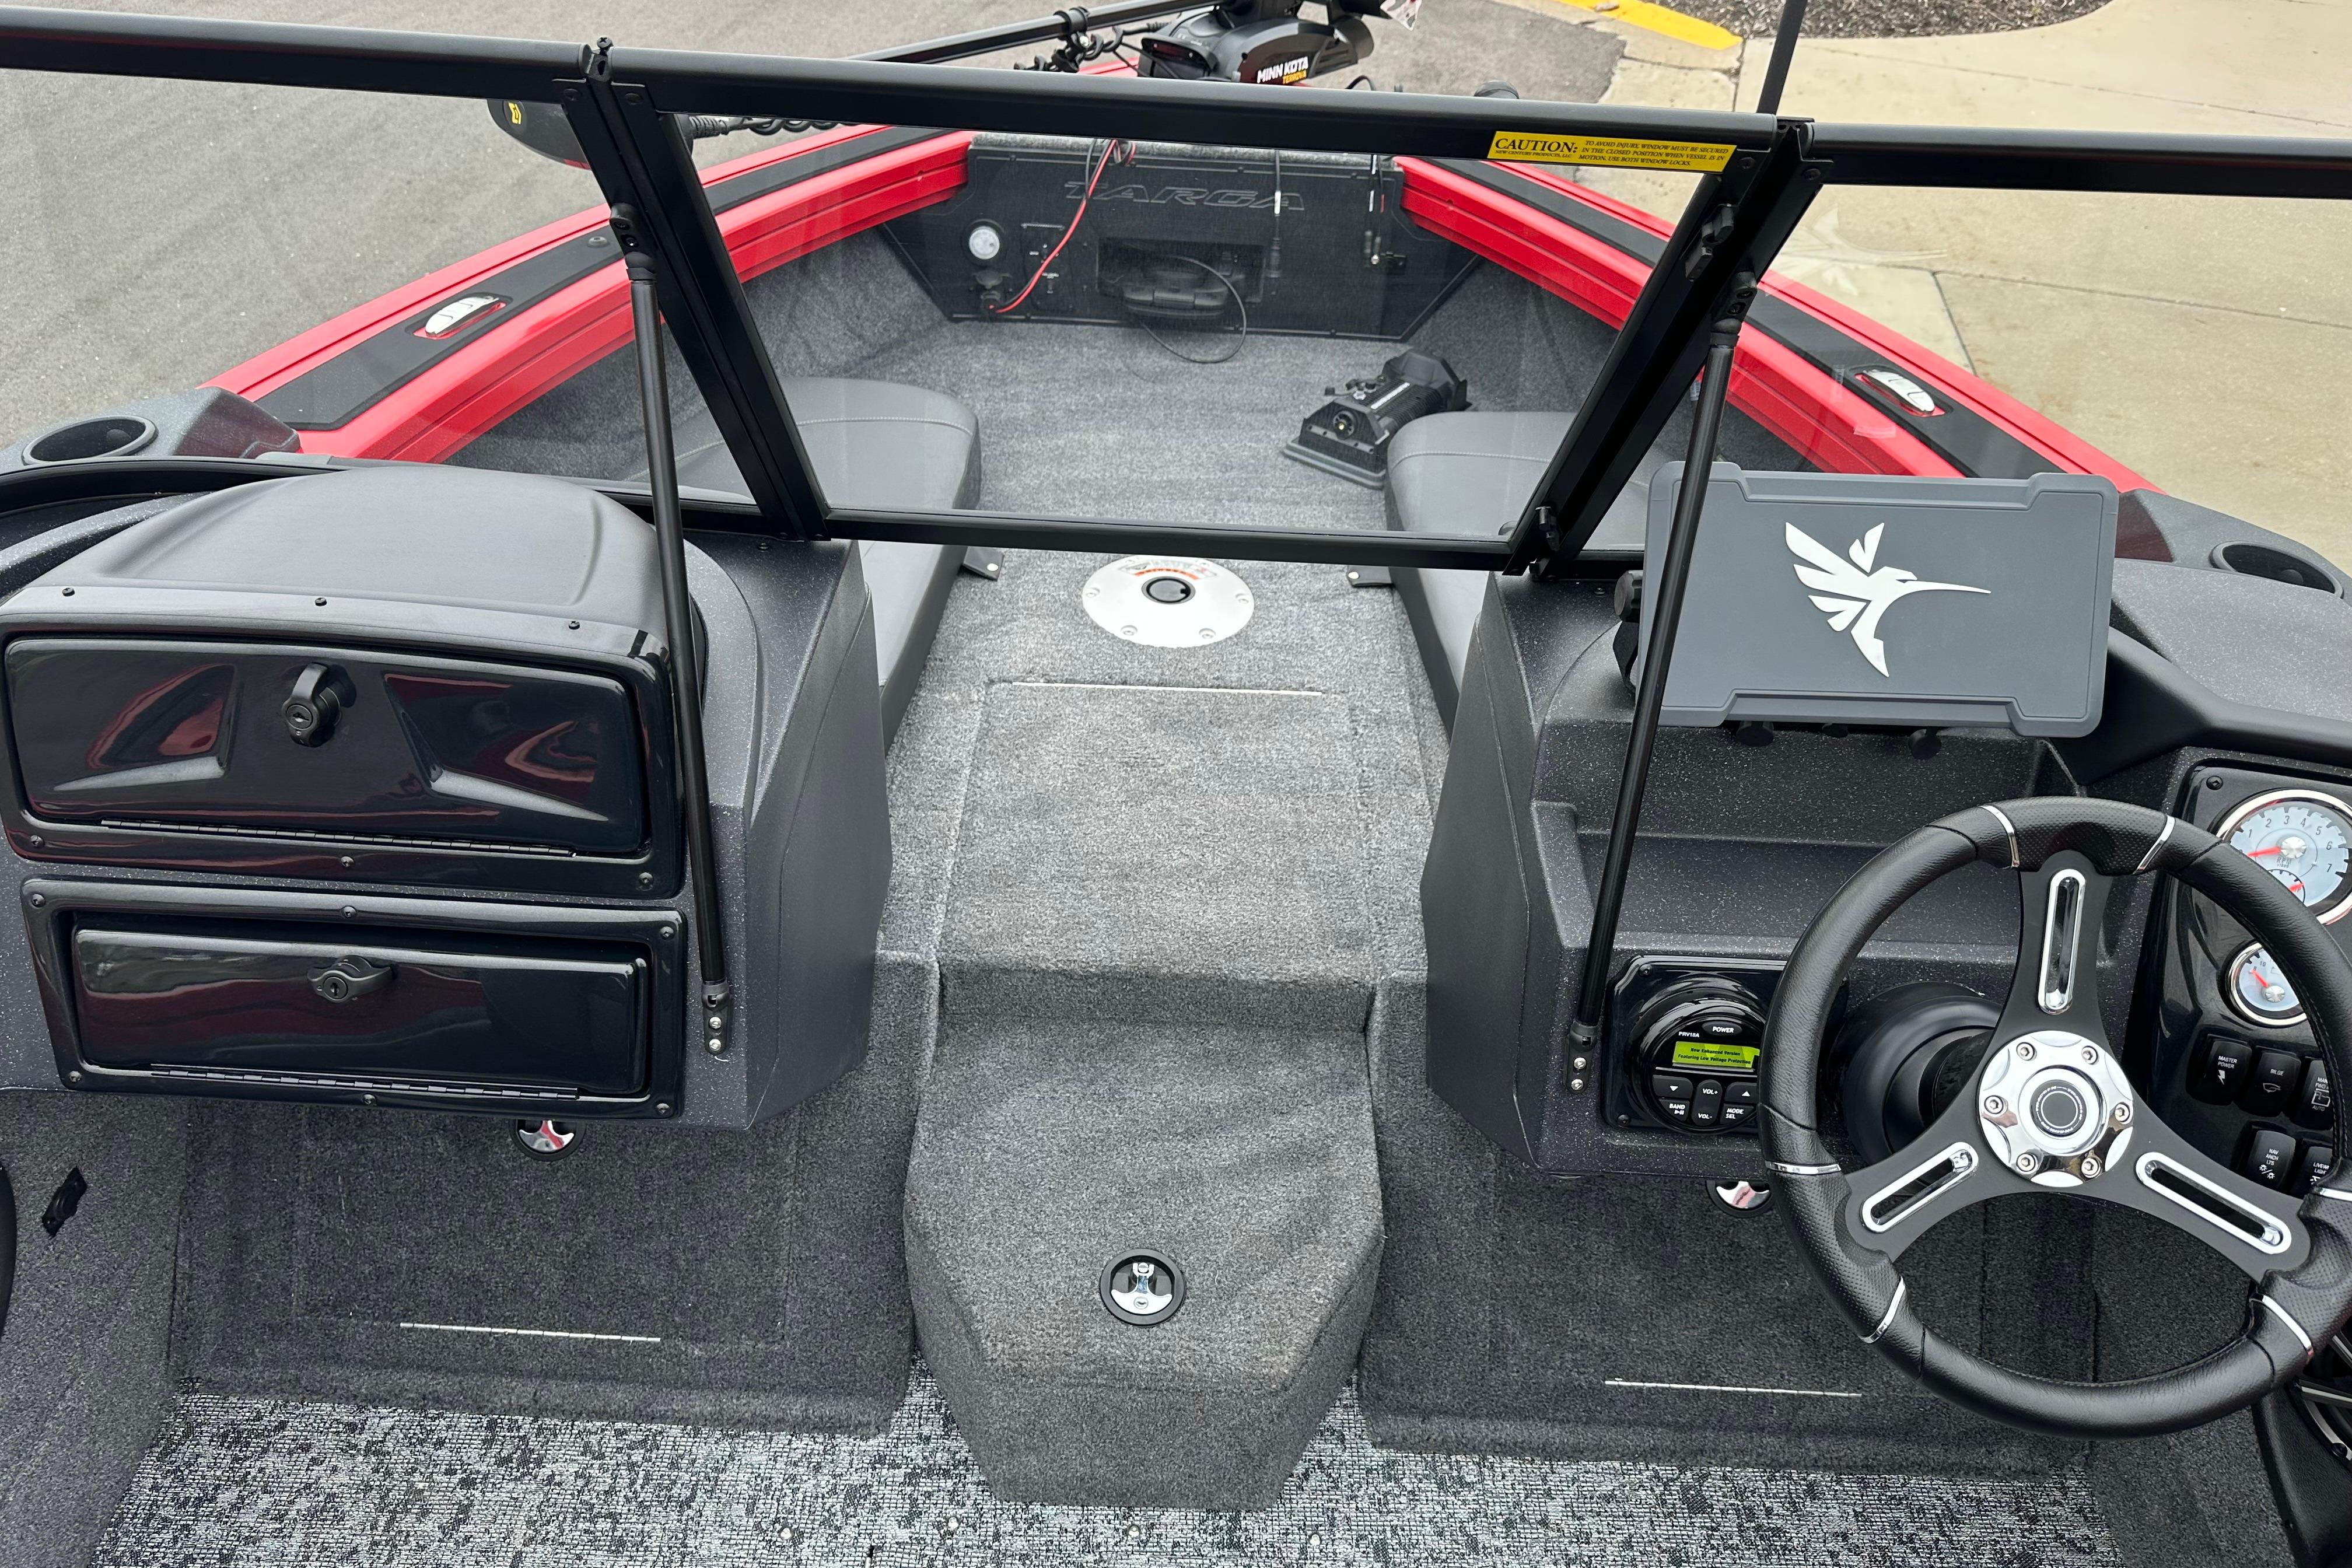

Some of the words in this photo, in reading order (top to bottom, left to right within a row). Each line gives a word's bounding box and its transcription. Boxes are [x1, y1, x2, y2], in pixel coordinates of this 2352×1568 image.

[1257, 63, 1283, 83] MINN
[1283, 56, 1308, 75] KOTA
[1495, 138, 1578, 153] CAUTION:
[1064, 181, 1305, 211] TARGA
[2265, 818, 2272, 828] 2
[2284, 816, 2290, 824] 3
[2301, 818, 2306, 827] 4
[2248, 829, 2252, 838] 1
[2315, 826, 2322, 835] 5
[2326, 841, 2333, 850] 6
[2276, 856, 2292, 864] RPM
[2326, 863, 2332, 873] 7
[2218, 1055, 2238, 1064] MASTER
